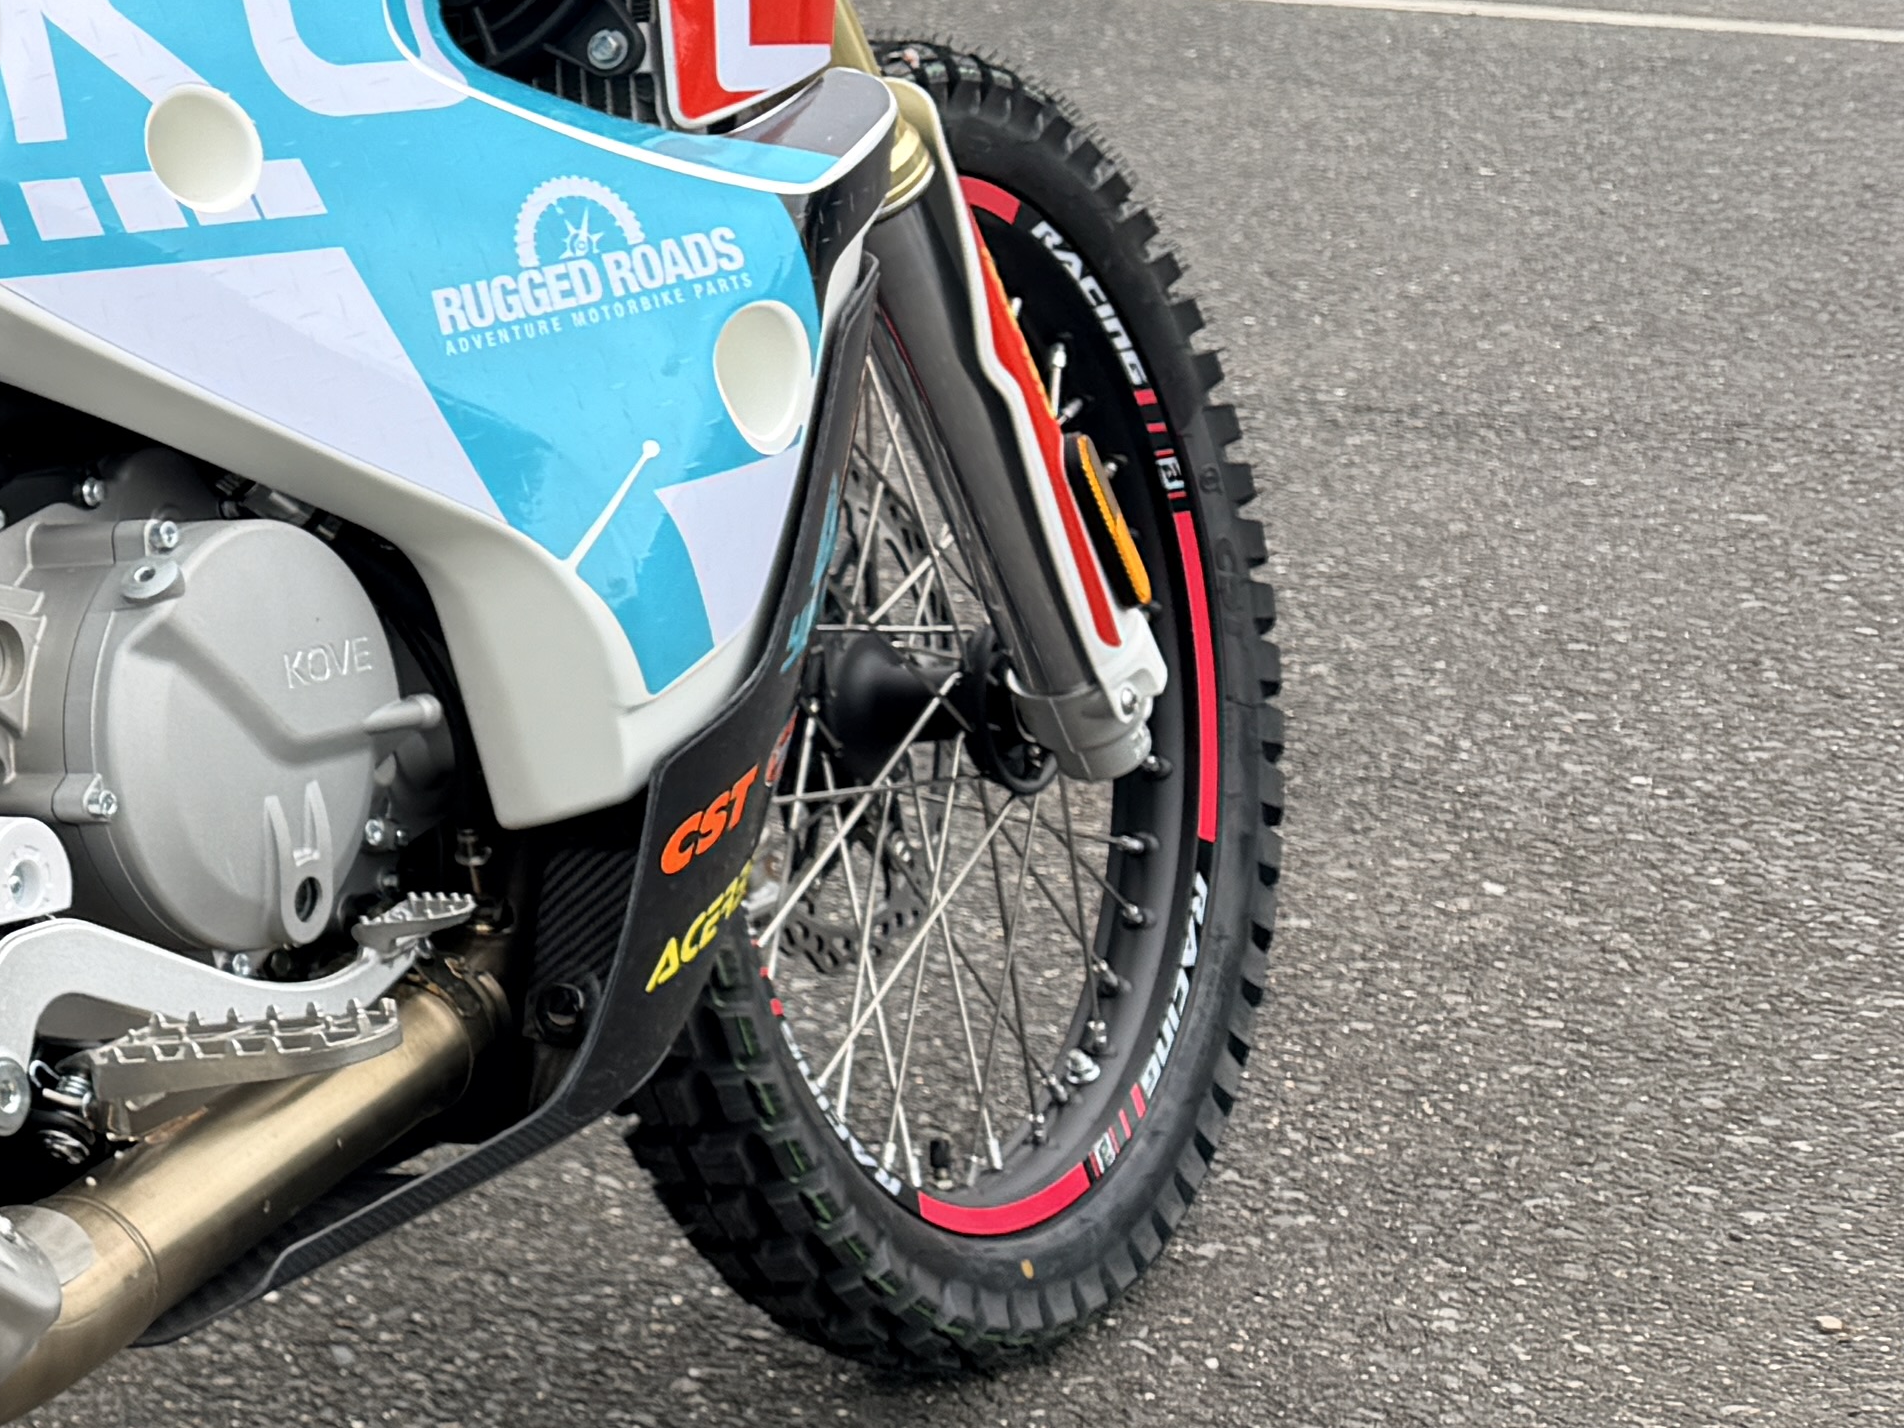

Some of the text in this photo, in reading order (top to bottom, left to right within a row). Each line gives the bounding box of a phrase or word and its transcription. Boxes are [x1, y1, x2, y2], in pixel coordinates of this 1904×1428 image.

[431, 226, 745, 336] RUGGED ROADS
[444, 272, 753, 357] ADVENTURE MOTORBIKE PARTS
[1030, 219, 1148, 388] RACING
[283, 636, 373, 690] KOVE
[660, 762, 760, 876] CST
[1138, 871, 1209, 1101] RACING
